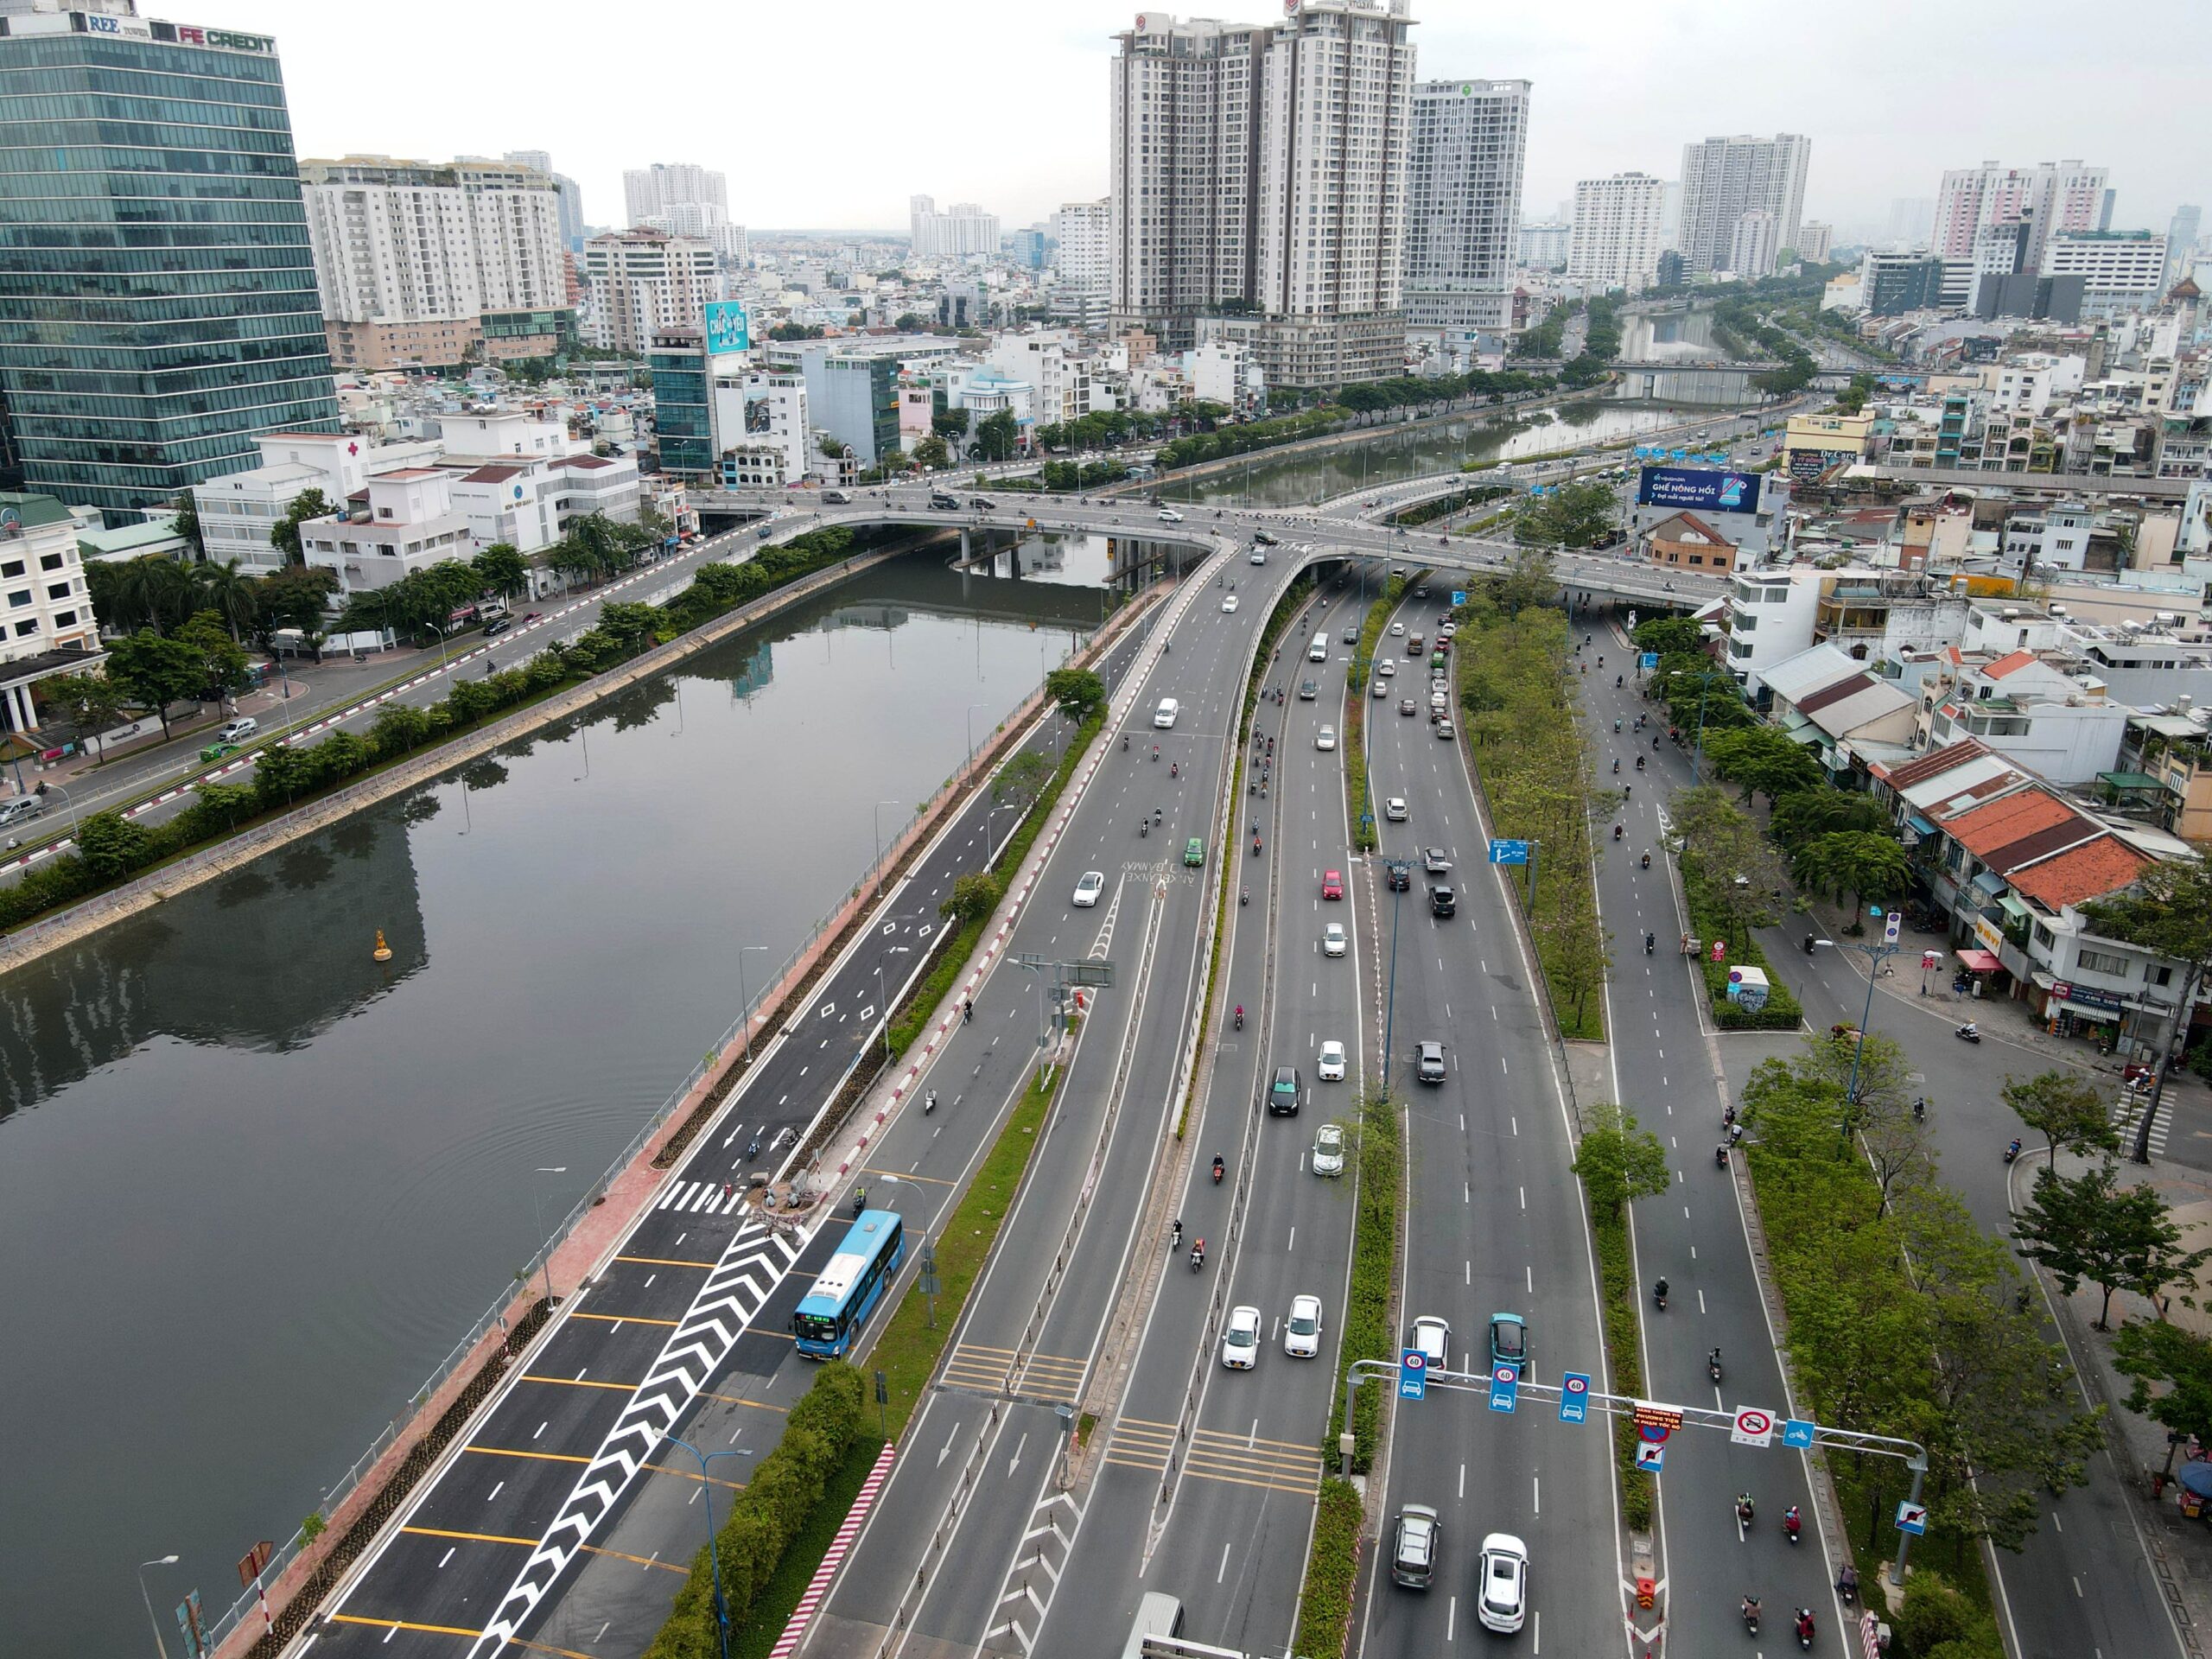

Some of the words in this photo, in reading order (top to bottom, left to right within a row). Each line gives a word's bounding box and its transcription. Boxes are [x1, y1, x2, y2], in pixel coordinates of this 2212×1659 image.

[89, 16, 120, 34] REE
[179, 27, 205, 45] FE
[207, 31, 275, 53] CREDIT
[1652, 482, 1669, 492] GHẾ
[1672, 484, 1696, 493] NÓNG
[1636, 1413, 1663, 1421] PHƯƠNG
